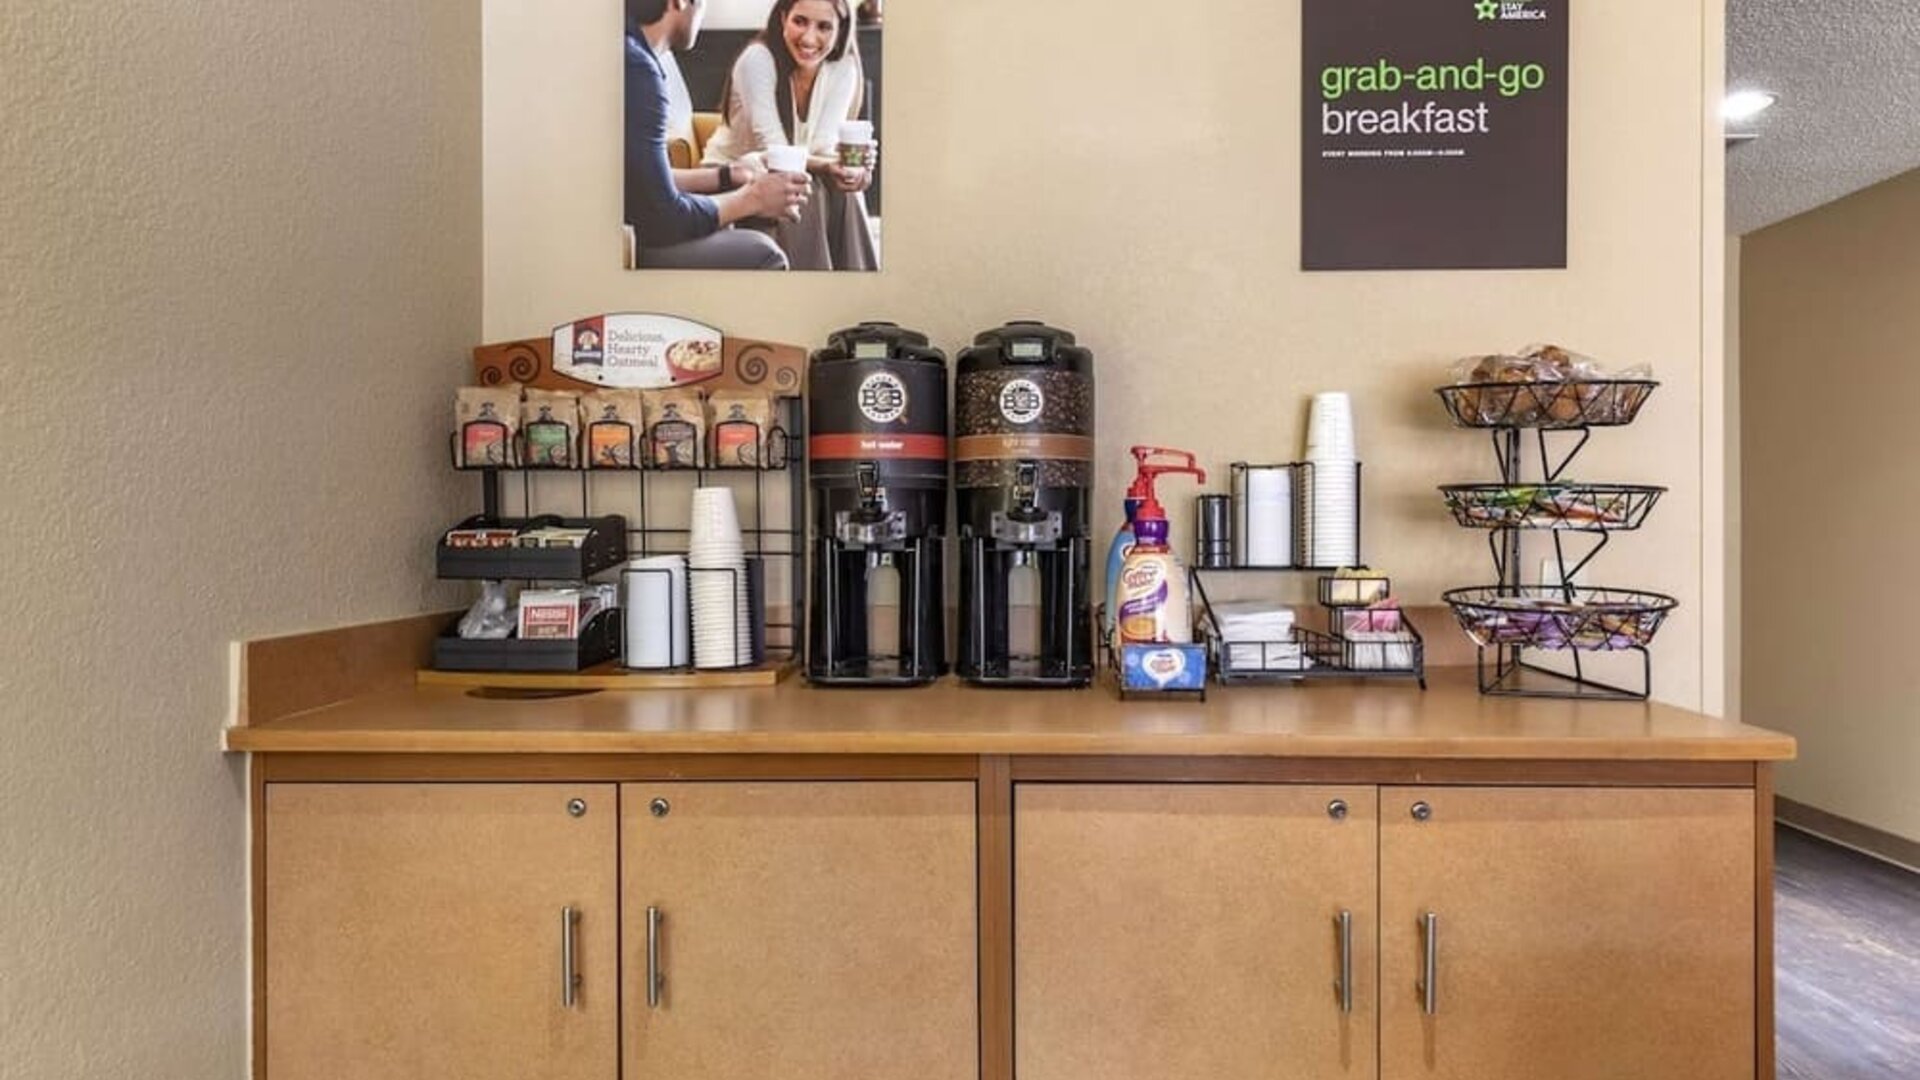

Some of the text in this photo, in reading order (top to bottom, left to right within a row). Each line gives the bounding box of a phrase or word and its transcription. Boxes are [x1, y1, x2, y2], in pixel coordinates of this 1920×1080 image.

[1501, 10, 1546, 20] AMERICA
[1321, 57, 1544, 98] grab-and-go
[1322, 102, 1489, 134] breakfast
[607, 343, 650, 356] Hearty
[607, 355, 658, 367] Oatmeal
